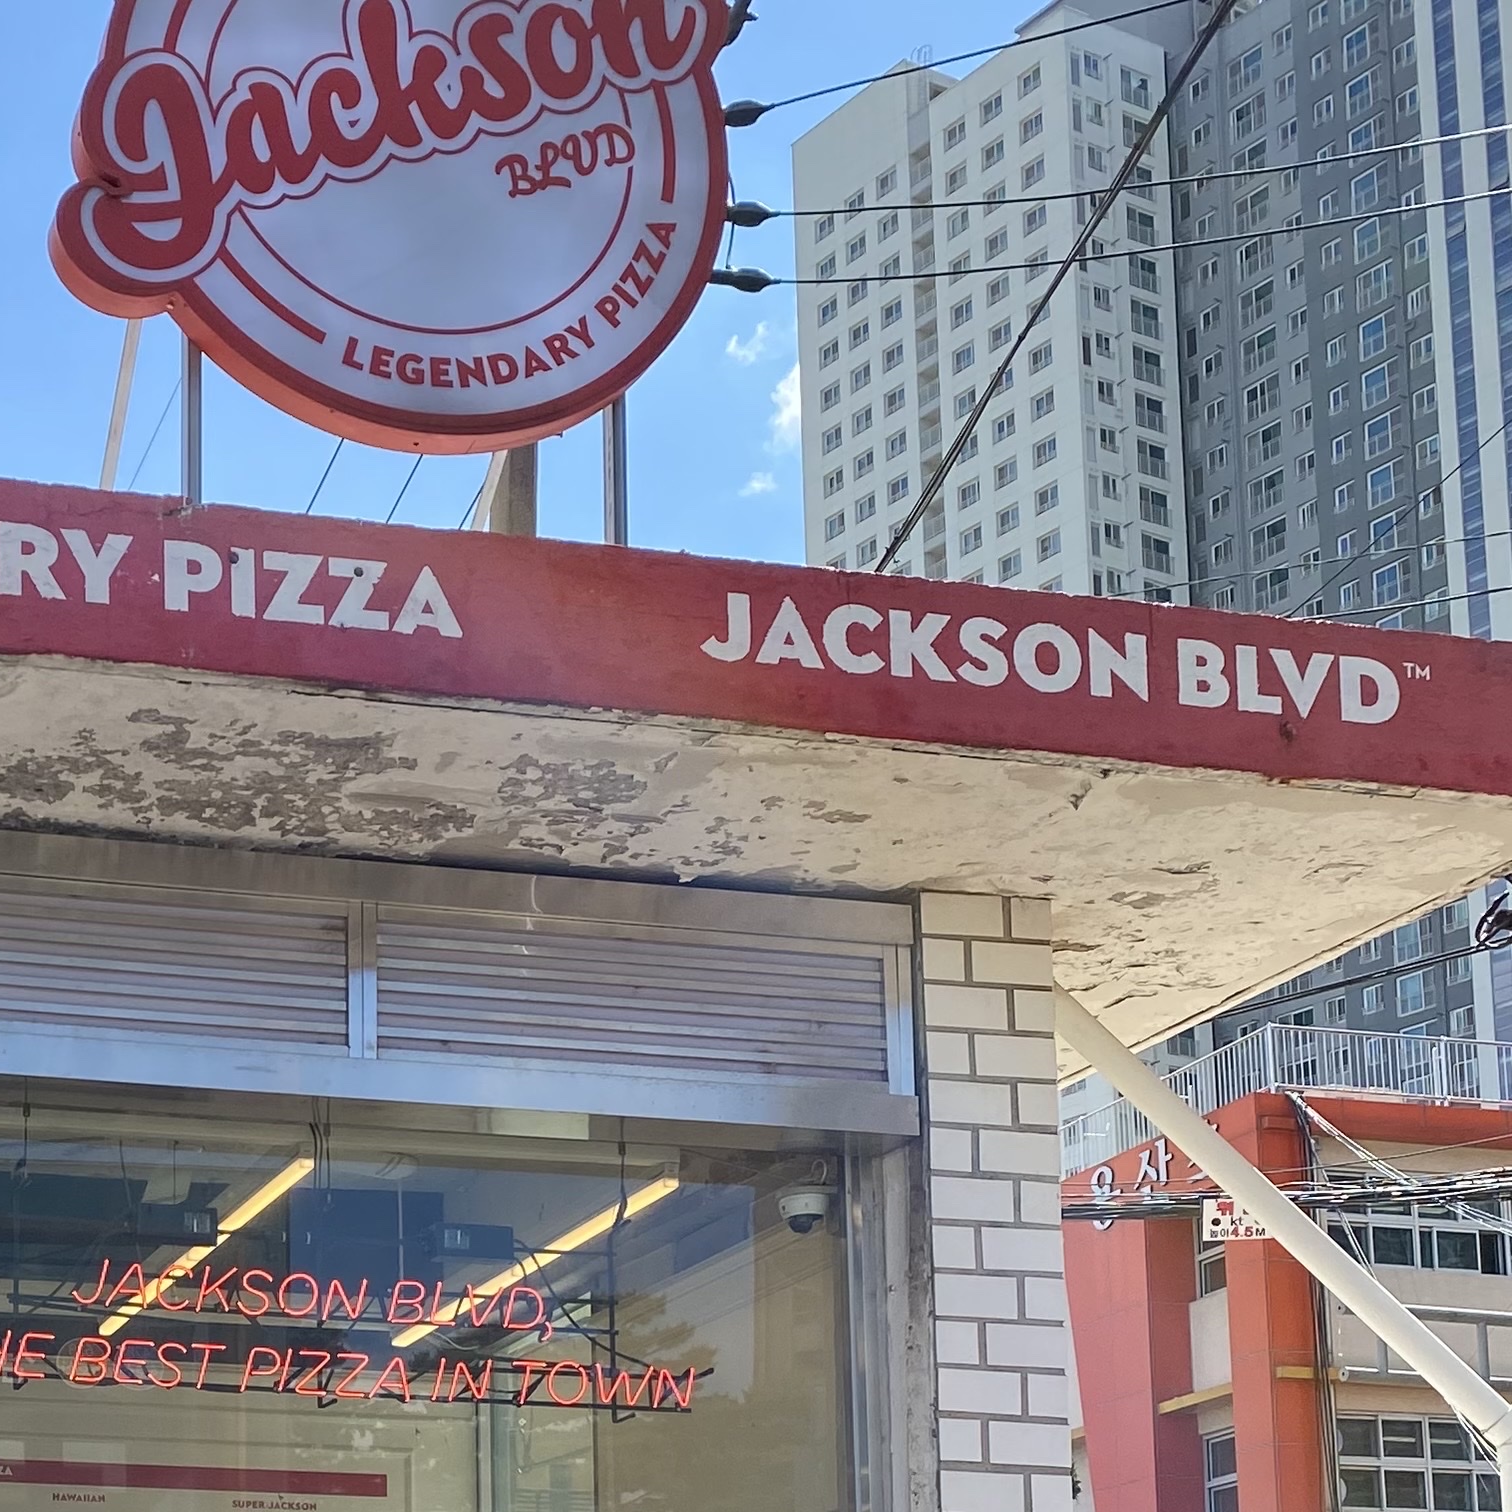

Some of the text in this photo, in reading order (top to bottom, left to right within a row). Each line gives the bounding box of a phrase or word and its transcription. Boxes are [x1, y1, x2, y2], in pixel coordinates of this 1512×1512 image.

[92, 0, 691, 269] Jackson
[495, 123, 635, 198] BLVD
[341, 221, 678, 388] LEGENDARY PIZZA
[162, 539, 465, 640] PIZZA
[699, 592, 1150, 703] JACKSON
[1177, 637, 1401, 726] BLVD
[71, 1258, 554, 1342] JACKSON BLVD,
[69, 1337, 227, 1390] BEST
[240, 1346, 412, 1402] PIZZA
[431, 1356, 492, 1402] IN
[511, 1359, 696, 1410] TOWN
[52, 1492, 106, 1503] HAWAIIAN
[232, 1500, 317, 1511] SUPER JACKSON
